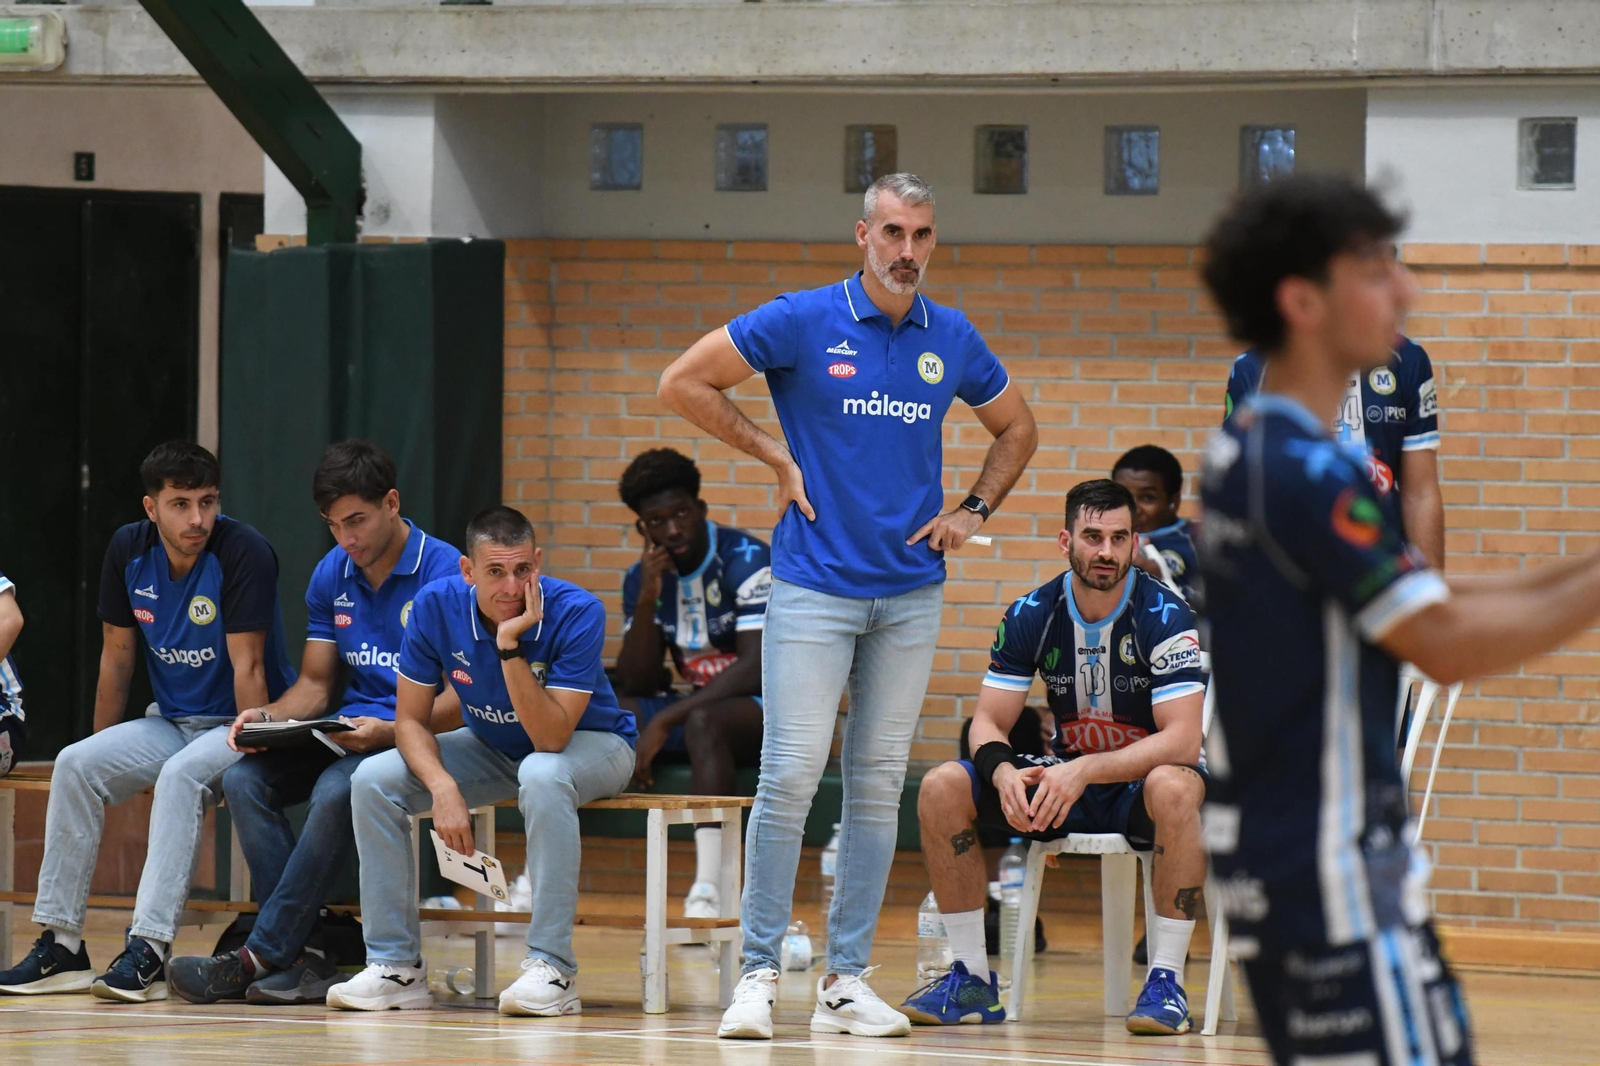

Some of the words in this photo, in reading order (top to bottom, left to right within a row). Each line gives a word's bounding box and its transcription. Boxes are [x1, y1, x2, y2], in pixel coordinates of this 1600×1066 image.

[826, 347, 858, 356] MERCURY
[828, 364, 856, 375] TROPS
[925, 361, 938, 374] M
[1376, 374, 1391, 386] M
[133, 609, 155, 623] TROPS
[194, 604, 209, 617] M
[334, 614, 352, 625] ROPS
[346, 642, 400, 673] málag
[466, 704, 519, 724] mála
[463, 862, 488, 882] T
